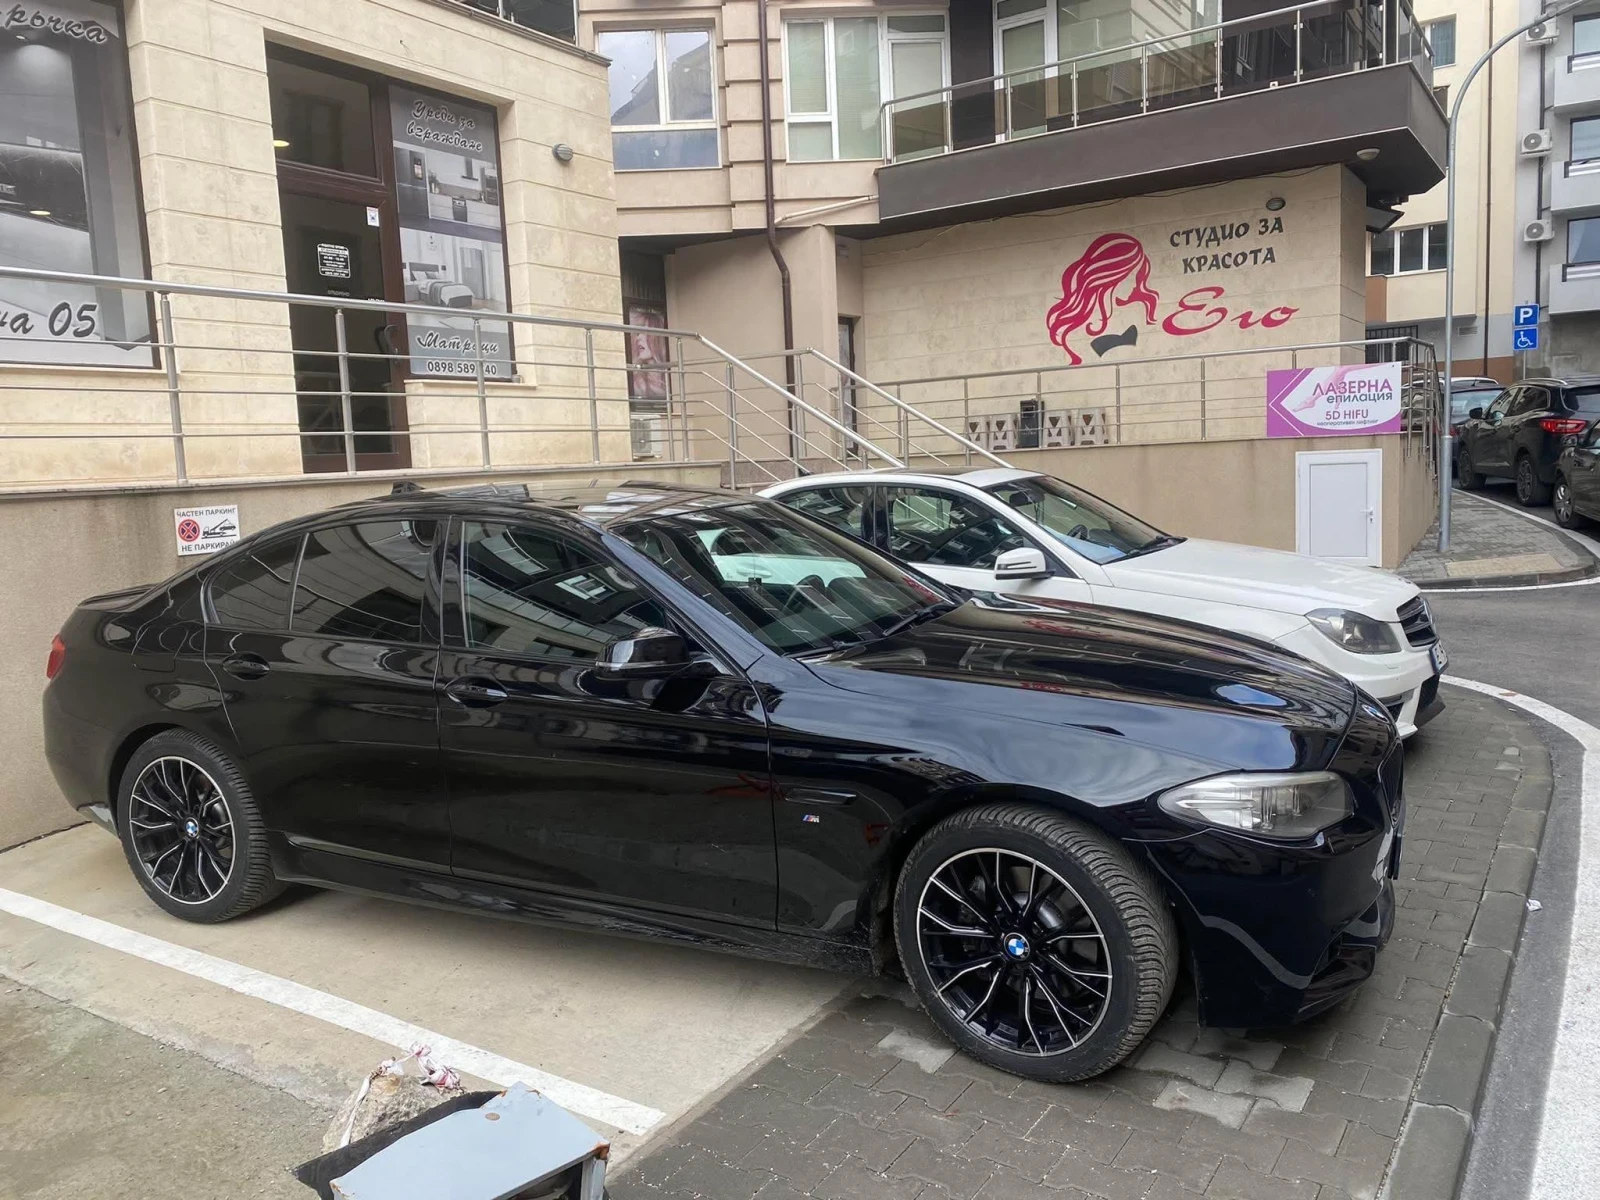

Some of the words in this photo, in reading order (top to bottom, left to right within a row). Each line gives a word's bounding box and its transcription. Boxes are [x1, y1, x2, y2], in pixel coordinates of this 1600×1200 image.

[412, 101, 455, 123] Уреди
[460, 117, 475, 130] за
[407, 121, 482, 151] вграждане
[1170, 223, 1250, 248] СТУДИО
[1258, 217, 1284, 235] ЗА
[1182, 247, 1276, 274] КРАСОТА
[49, 302, 97, 338] 05
[1520, 308, 1533, 324] P
[427, 361, 454, 373] 0898
[457, 362, 476, 374] 589
[1312, 379, 1393, 397] ЛАЗЕРНА
[1327, 392, 1393, 403] епилация
[1325, 411, 1341, 420] 5D
[1344, 409, 1369, 419] HIFU
